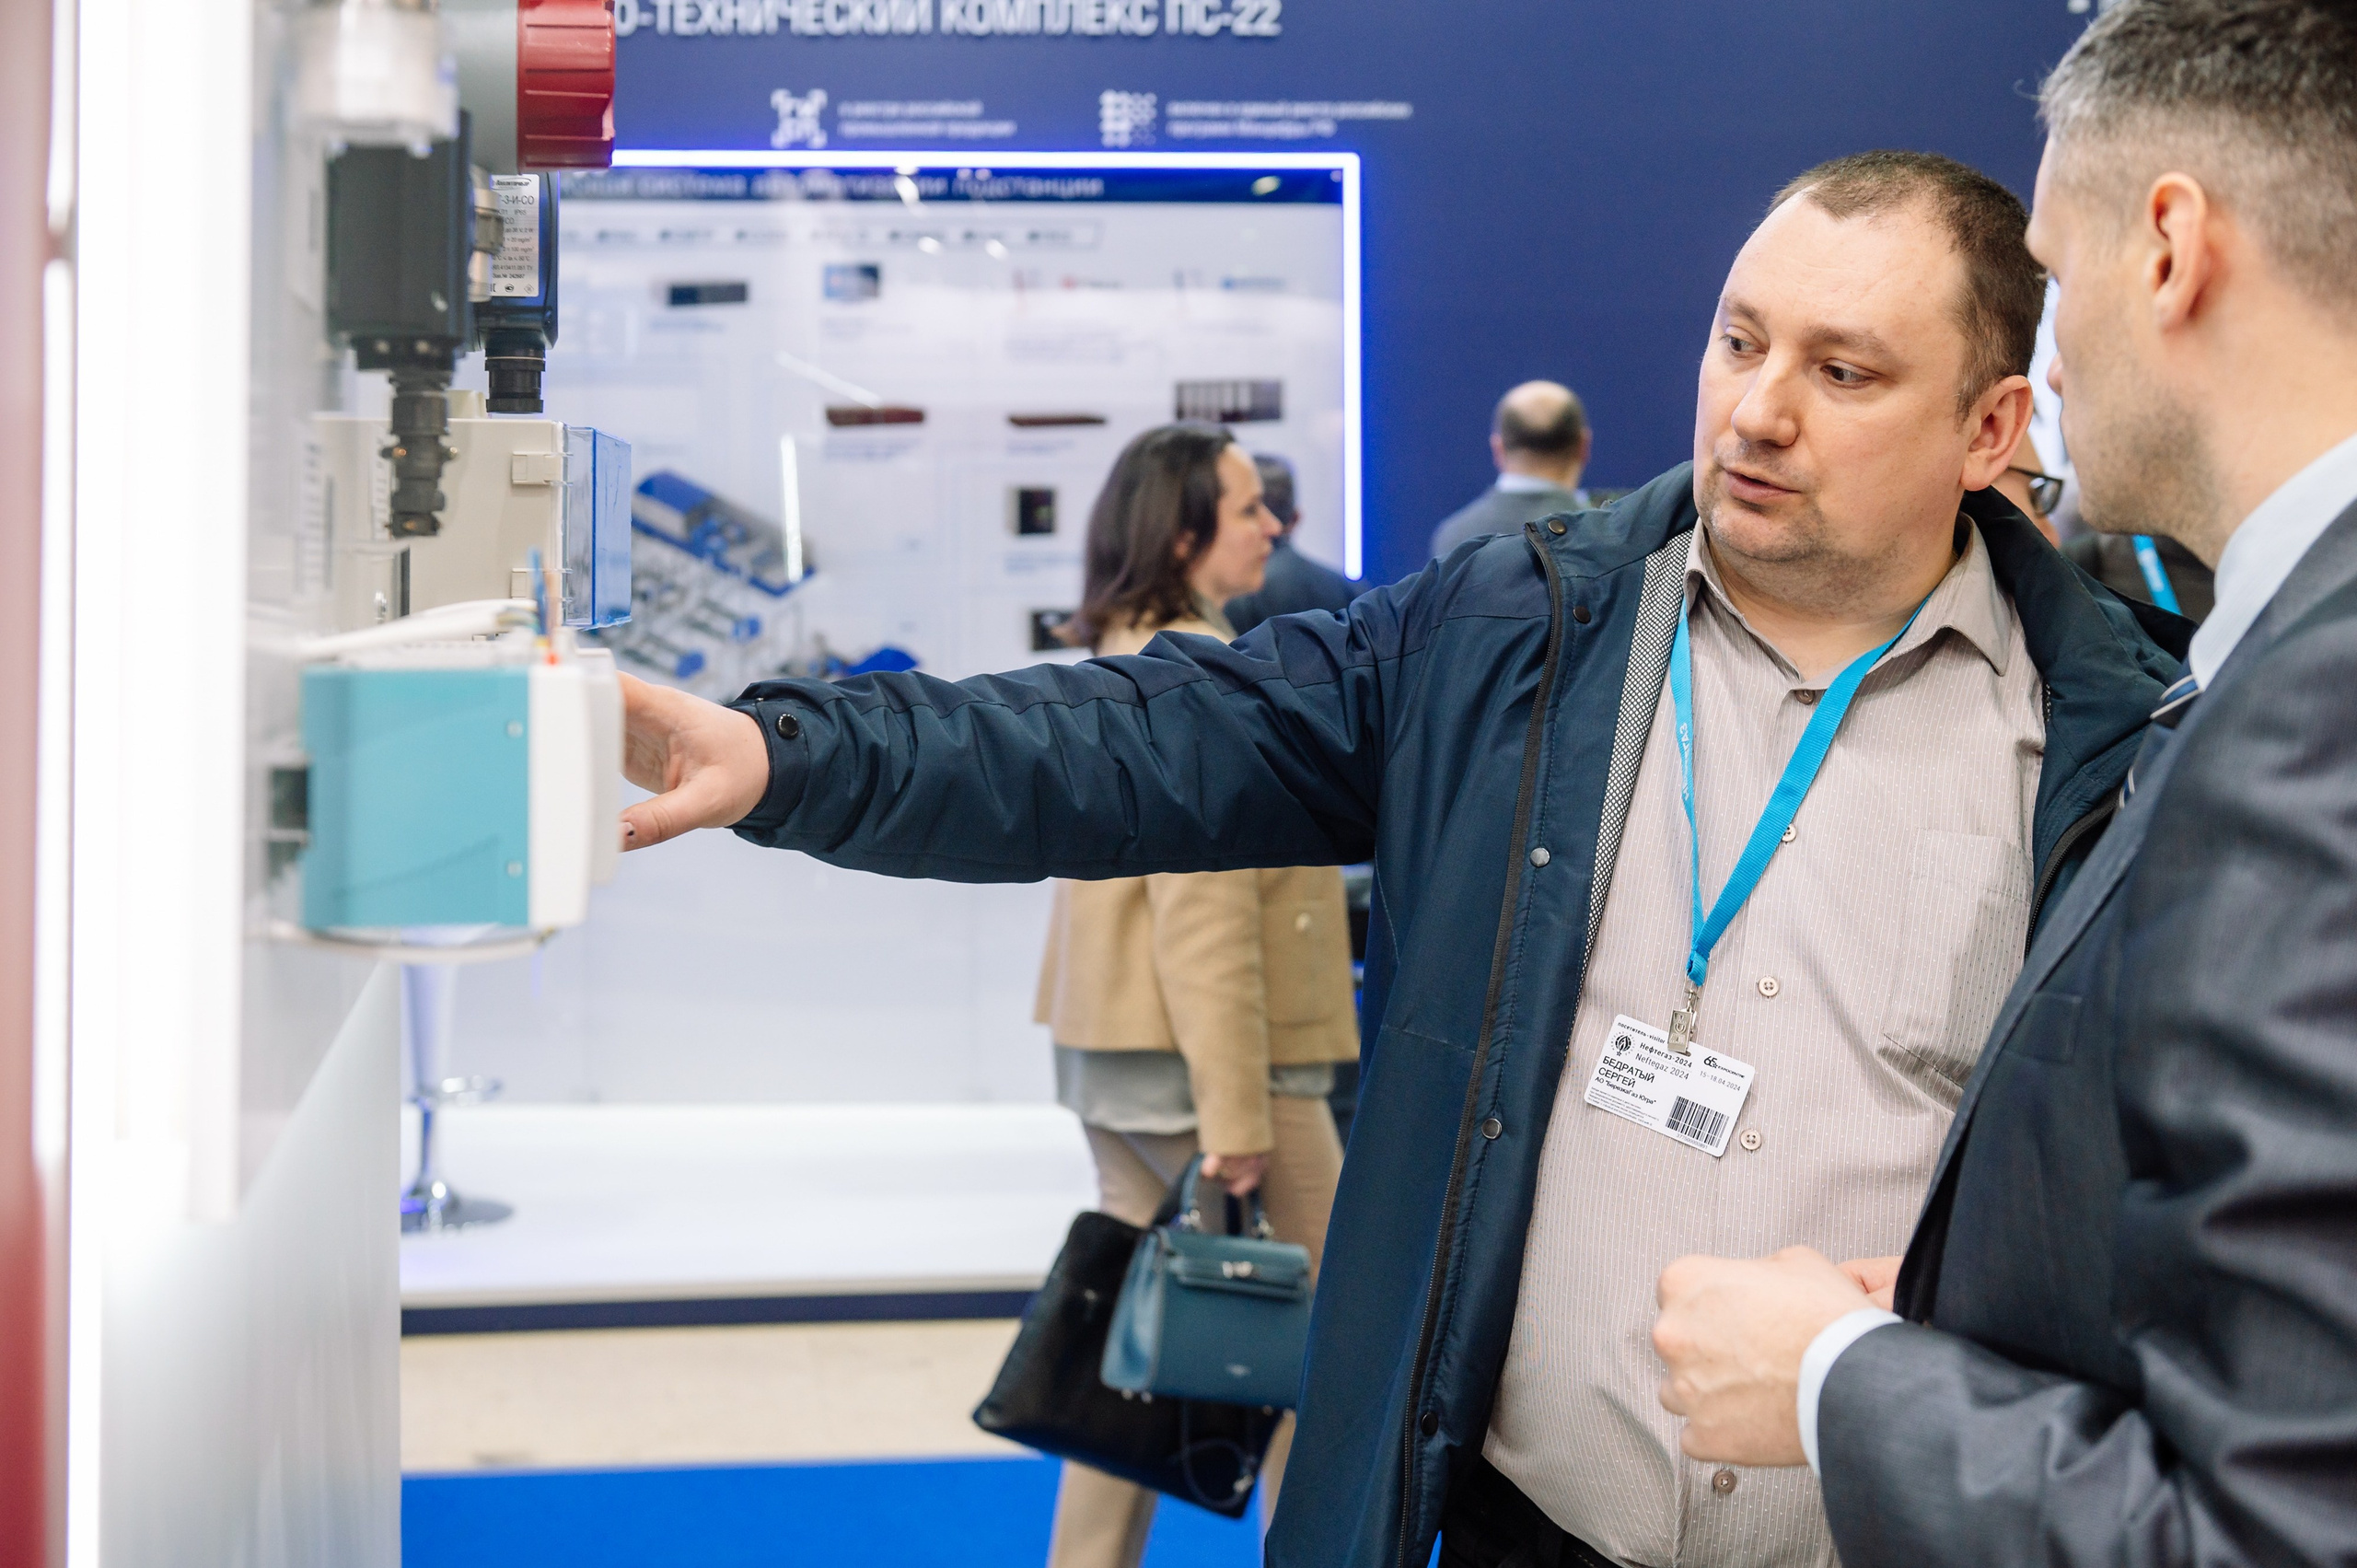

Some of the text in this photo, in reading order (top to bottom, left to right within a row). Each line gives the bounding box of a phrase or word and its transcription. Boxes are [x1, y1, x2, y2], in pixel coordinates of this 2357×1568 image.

[1598, 1066, 1636, 1088] СЕРГЕЙ
[1602, 1055, 1655, 1084] БЕДРАТЫЙ
[1635, 1052, 1689, 1080] Neftegaz 2024
